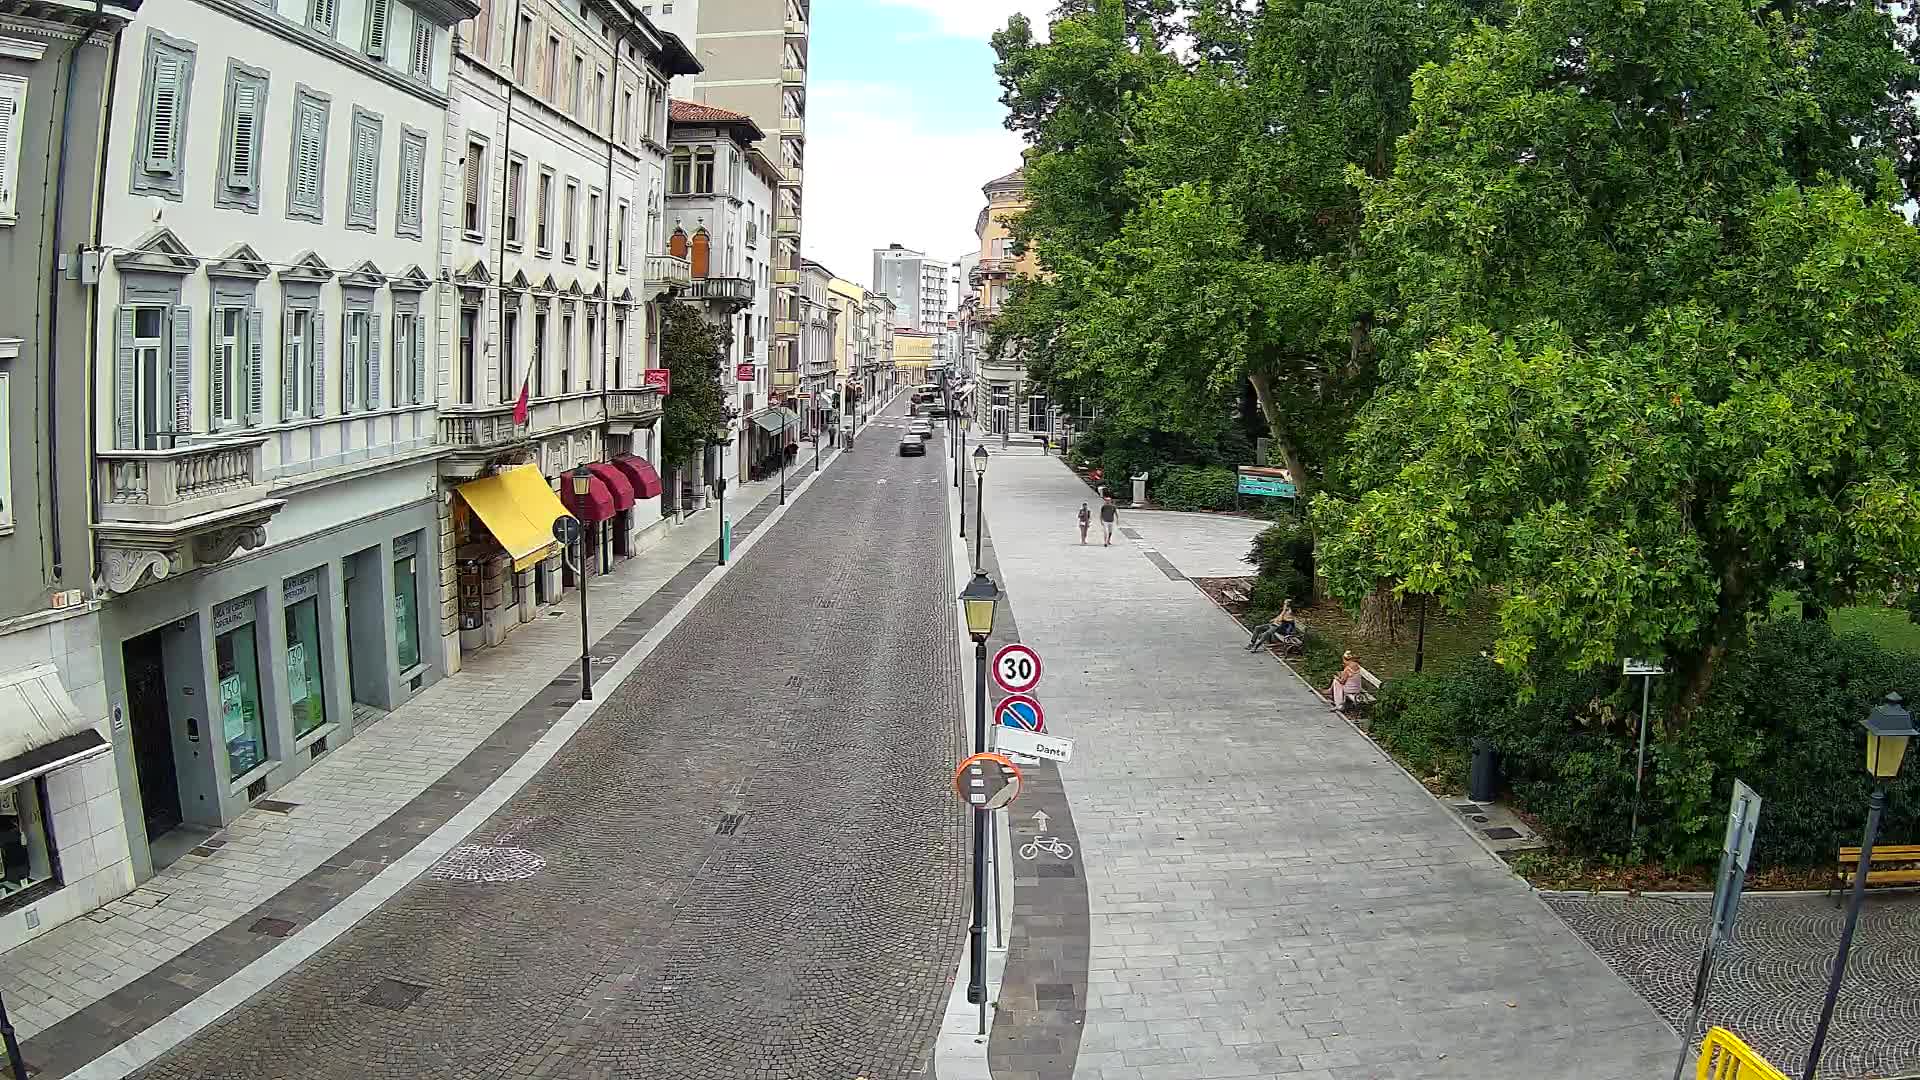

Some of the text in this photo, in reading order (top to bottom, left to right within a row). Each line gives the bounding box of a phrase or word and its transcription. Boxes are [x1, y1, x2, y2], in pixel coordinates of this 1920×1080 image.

[1004, 657, 1032, 680] 30
[220, 679, 239, 701] 130
[1036, 743, 1066, 756] Dante
